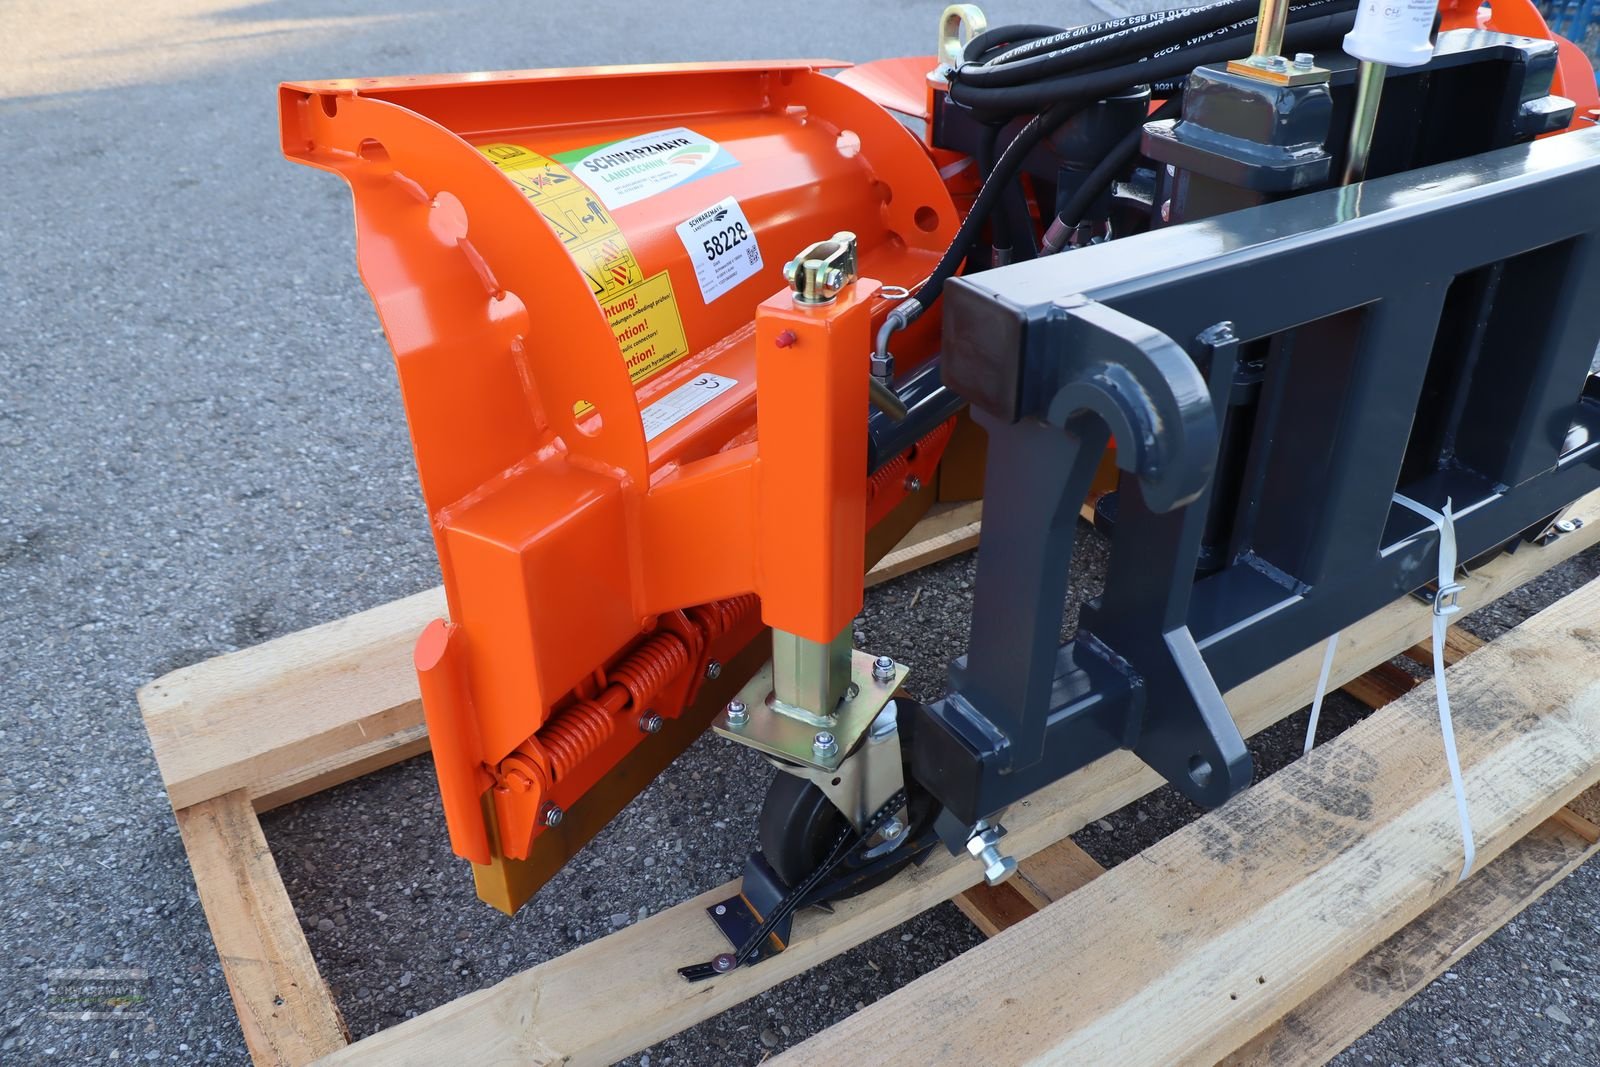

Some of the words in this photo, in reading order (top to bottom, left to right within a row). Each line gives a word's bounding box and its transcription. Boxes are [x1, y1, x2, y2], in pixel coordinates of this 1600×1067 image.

[1091, 23, 1103, 32] 10
[1105, 19, 1126, 30] 2SN
[1129, 14, 1147, 25] 853
[1150, 11, 1166, 21] EN
[1055, 31, 1071, 42] 330
[1072, 26, 1089, 37] WP
[583, 137, 693, 173] SCHWARZMAYR
[600, 157, 669, 184] LANDTECHNIK
[688, 205, 723, 228] SCHWARZMAYR
[703, 221, 748, 261] 58228
[604, 293, 639, 319] htung!
[616, 318, 649, 345] ntion!
[626, 344, 656, 370] ntion!
